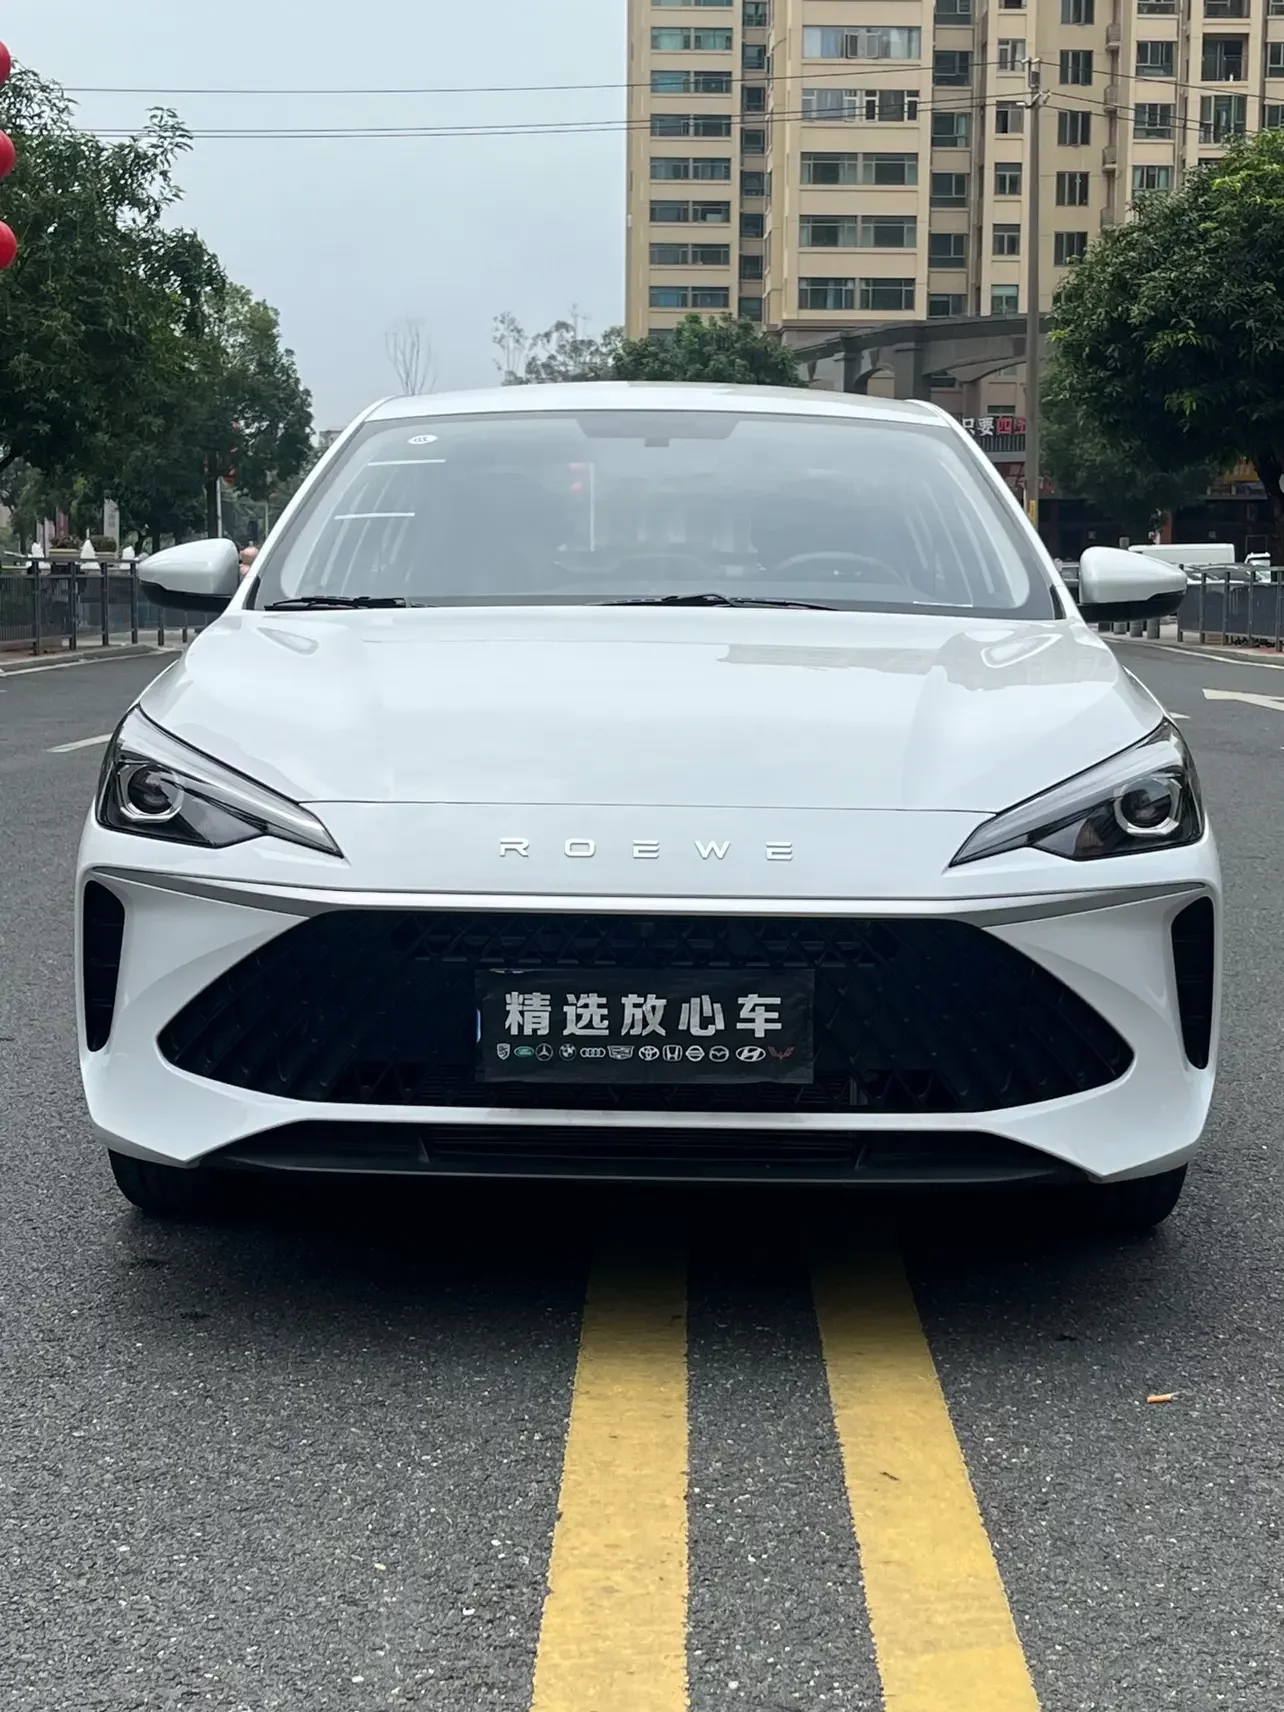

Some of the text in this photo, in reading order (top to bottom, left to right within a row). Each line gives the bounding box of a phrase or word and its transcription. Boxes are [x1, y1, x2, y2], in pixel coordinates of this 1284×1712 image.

[499, 837, 794, 862] ROEWE
[504, 991, 783, 1039] 精选放心车
